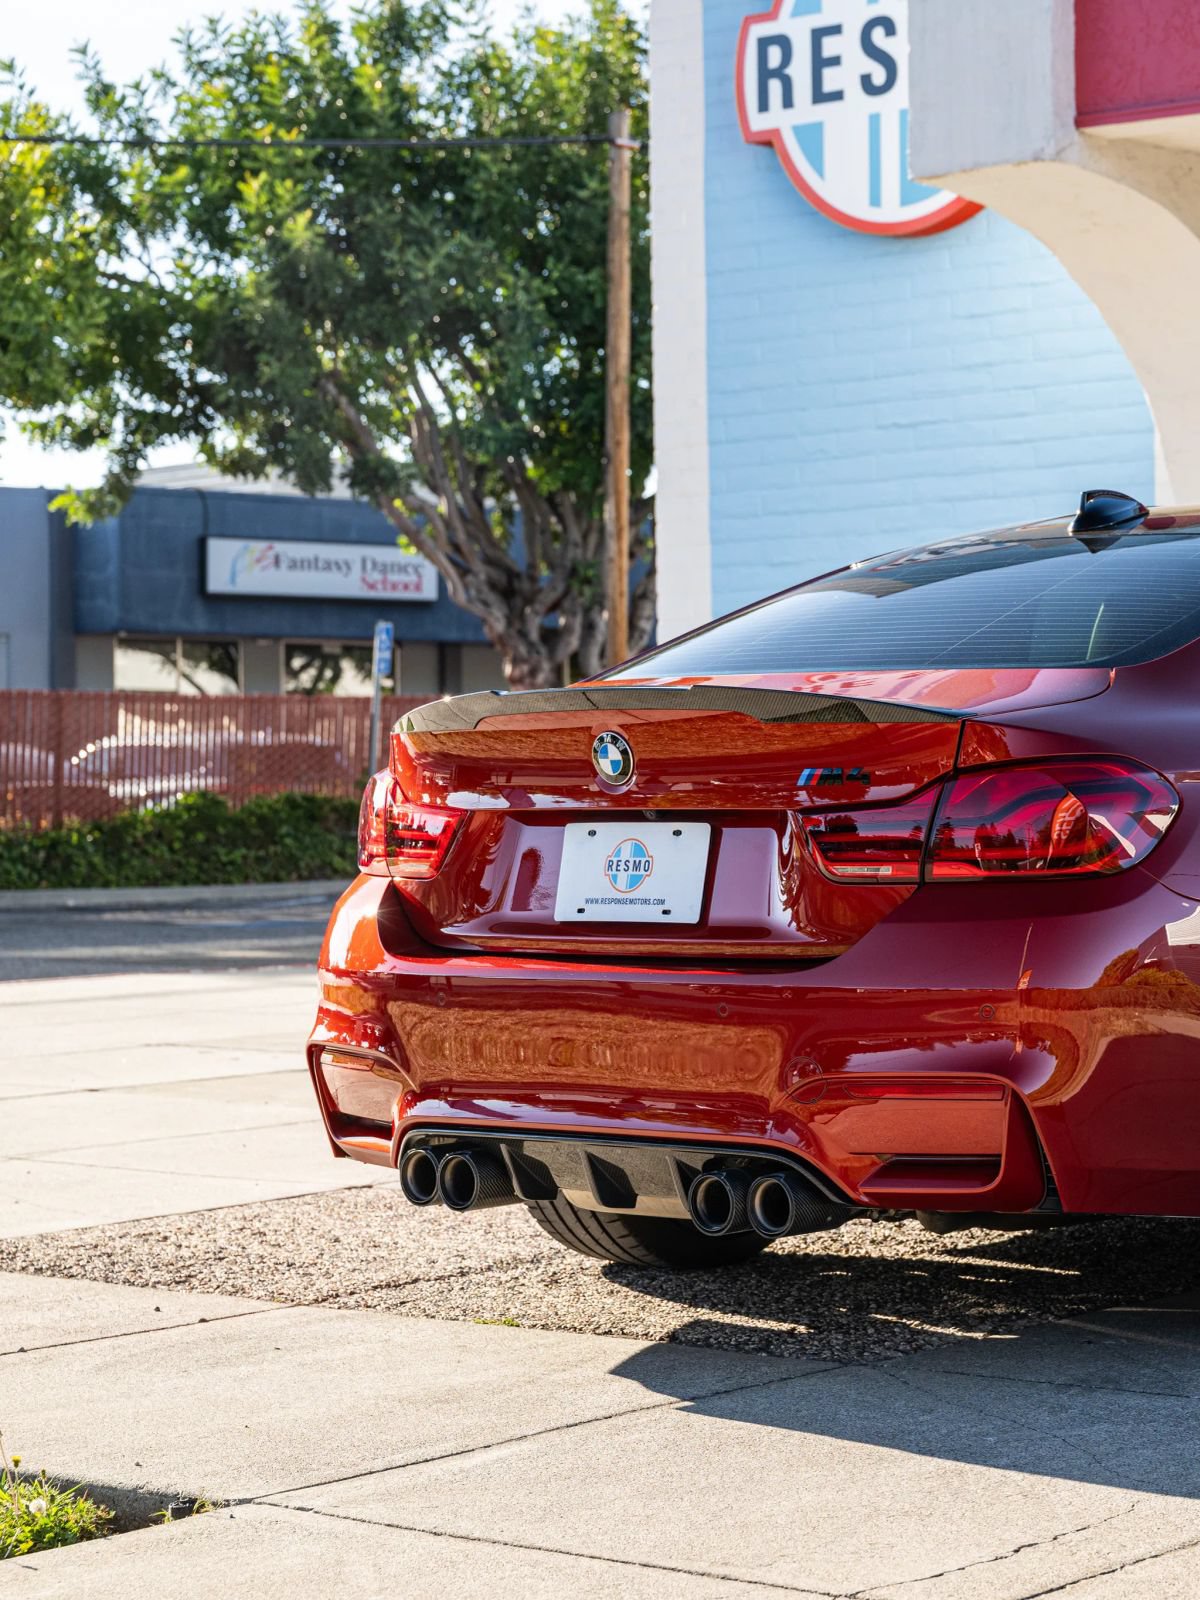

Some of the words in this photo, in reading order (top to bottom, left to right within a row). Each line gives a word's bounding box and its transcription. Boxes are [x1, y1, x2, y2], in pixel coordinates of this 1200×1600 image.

[360, 575, 424, 593] School
[594, 734, 626, 751] BMW
[607, 859, 651, 873] RESMO
[584, 897, 666, 906] WWW.RESPONSEMOTORS.COM
